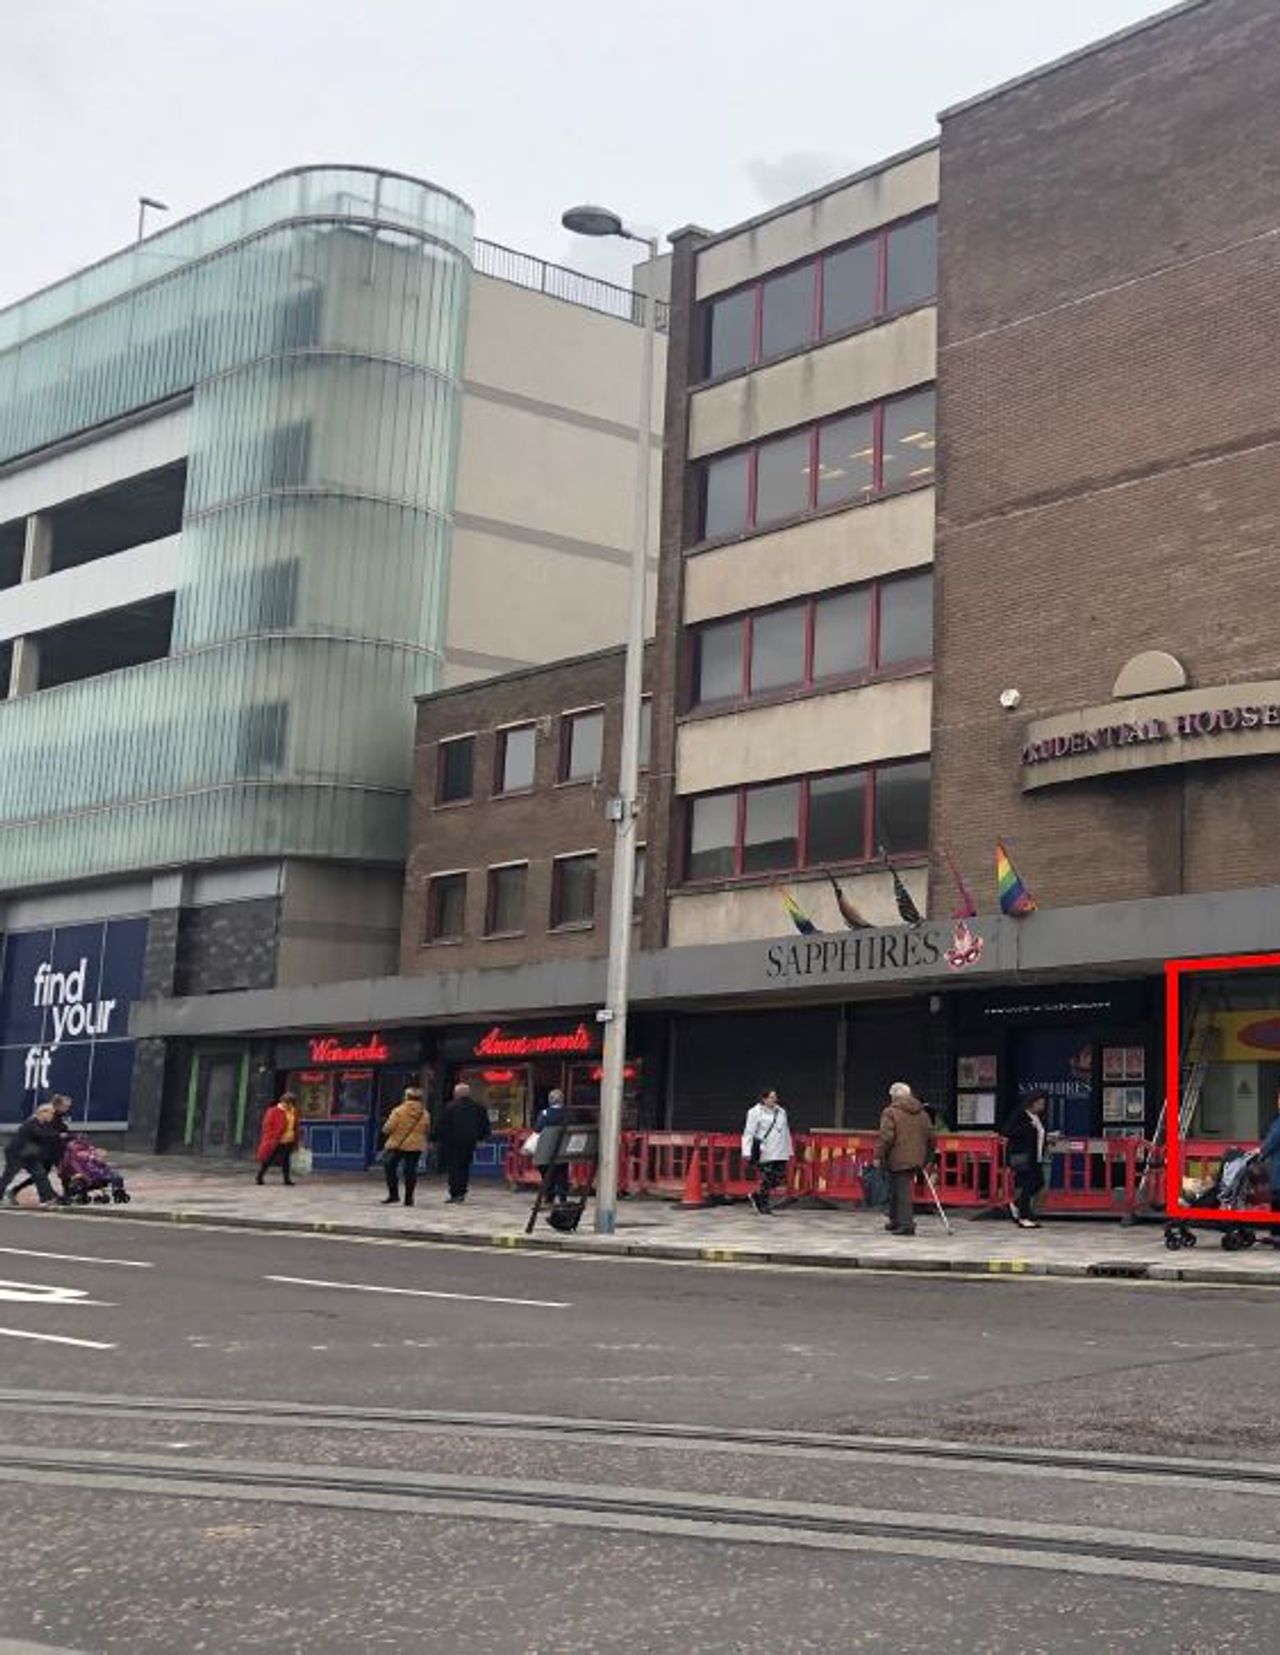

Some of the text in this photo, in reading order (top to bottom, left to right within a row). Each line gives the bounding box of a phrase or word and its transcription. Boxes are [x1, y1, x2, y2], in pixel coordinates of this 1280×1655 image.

[767, 930, 940, 977] SAPPHIRES
[34, 959, 87, 1006] find
[52, 999, 116, 1051] your
[25, 1045, 51, 1090] fit
